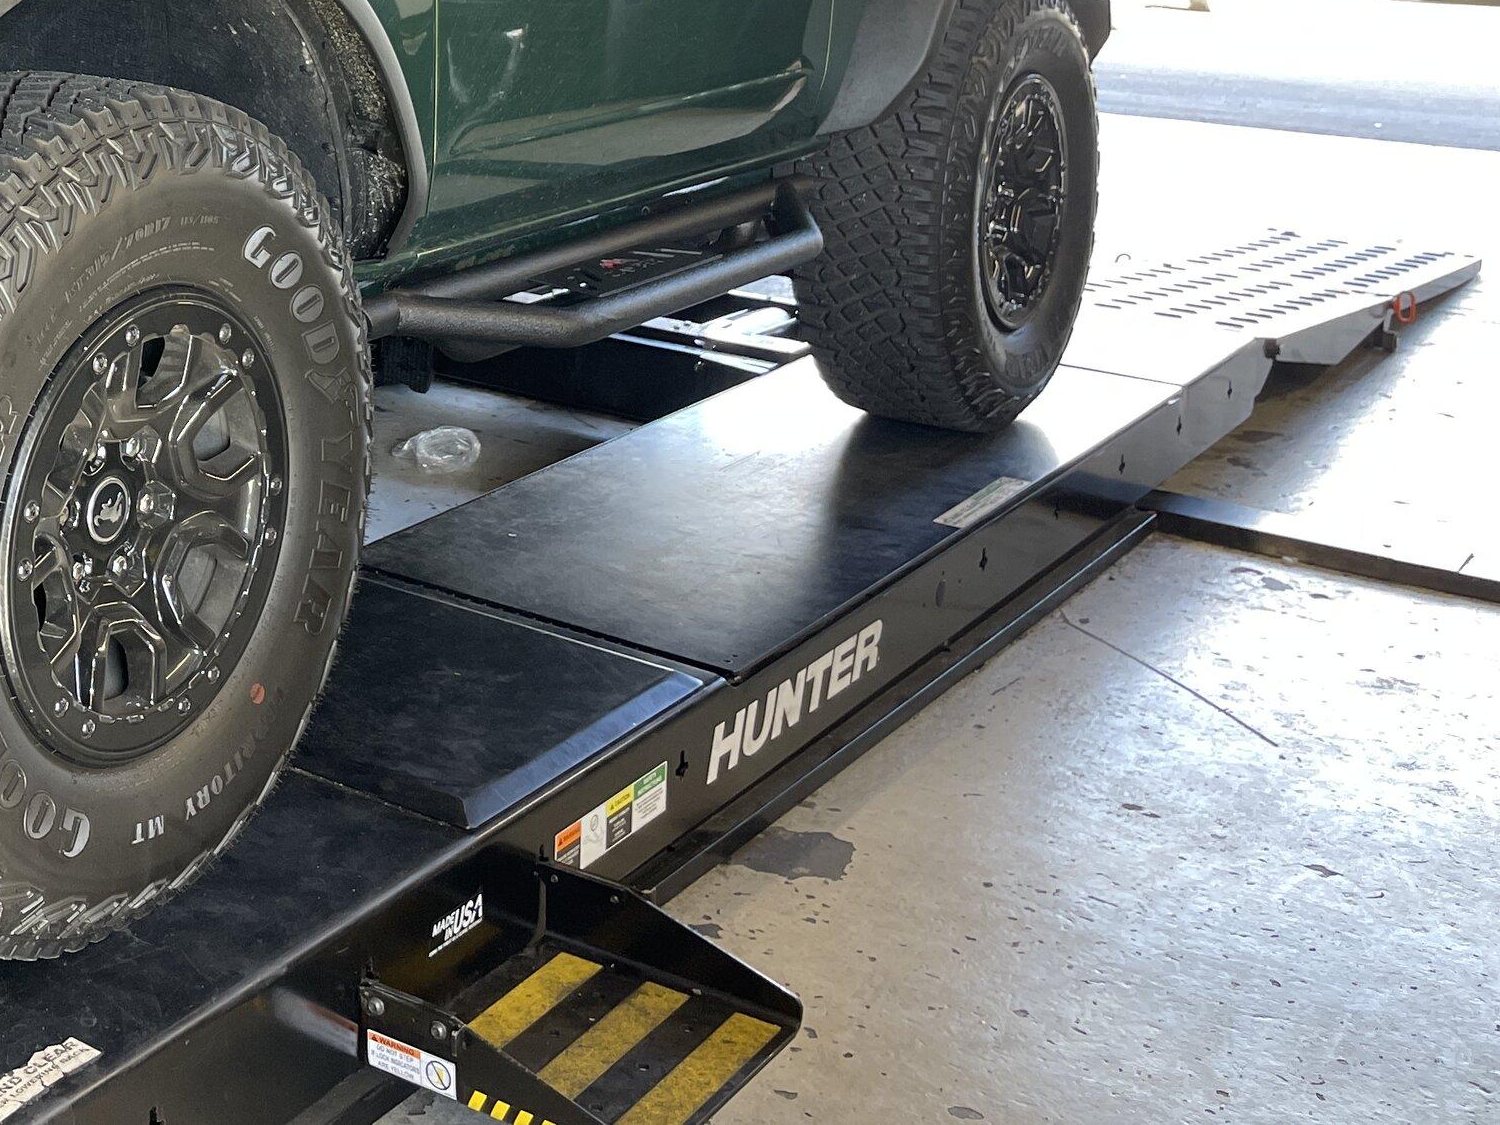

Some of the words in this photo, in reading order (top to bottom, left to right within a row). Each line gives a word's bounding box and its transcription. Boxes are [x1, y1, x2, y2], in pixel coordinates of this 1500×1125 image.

[706, 619, 883, 785] HUNTER
[453, 893, 483, 934] USA
[23, 1040, 79, 1075] CLEAR
[379, 1035, 415, 1056] WARNING
[9, 1063, 61, 1098] LOWERING
